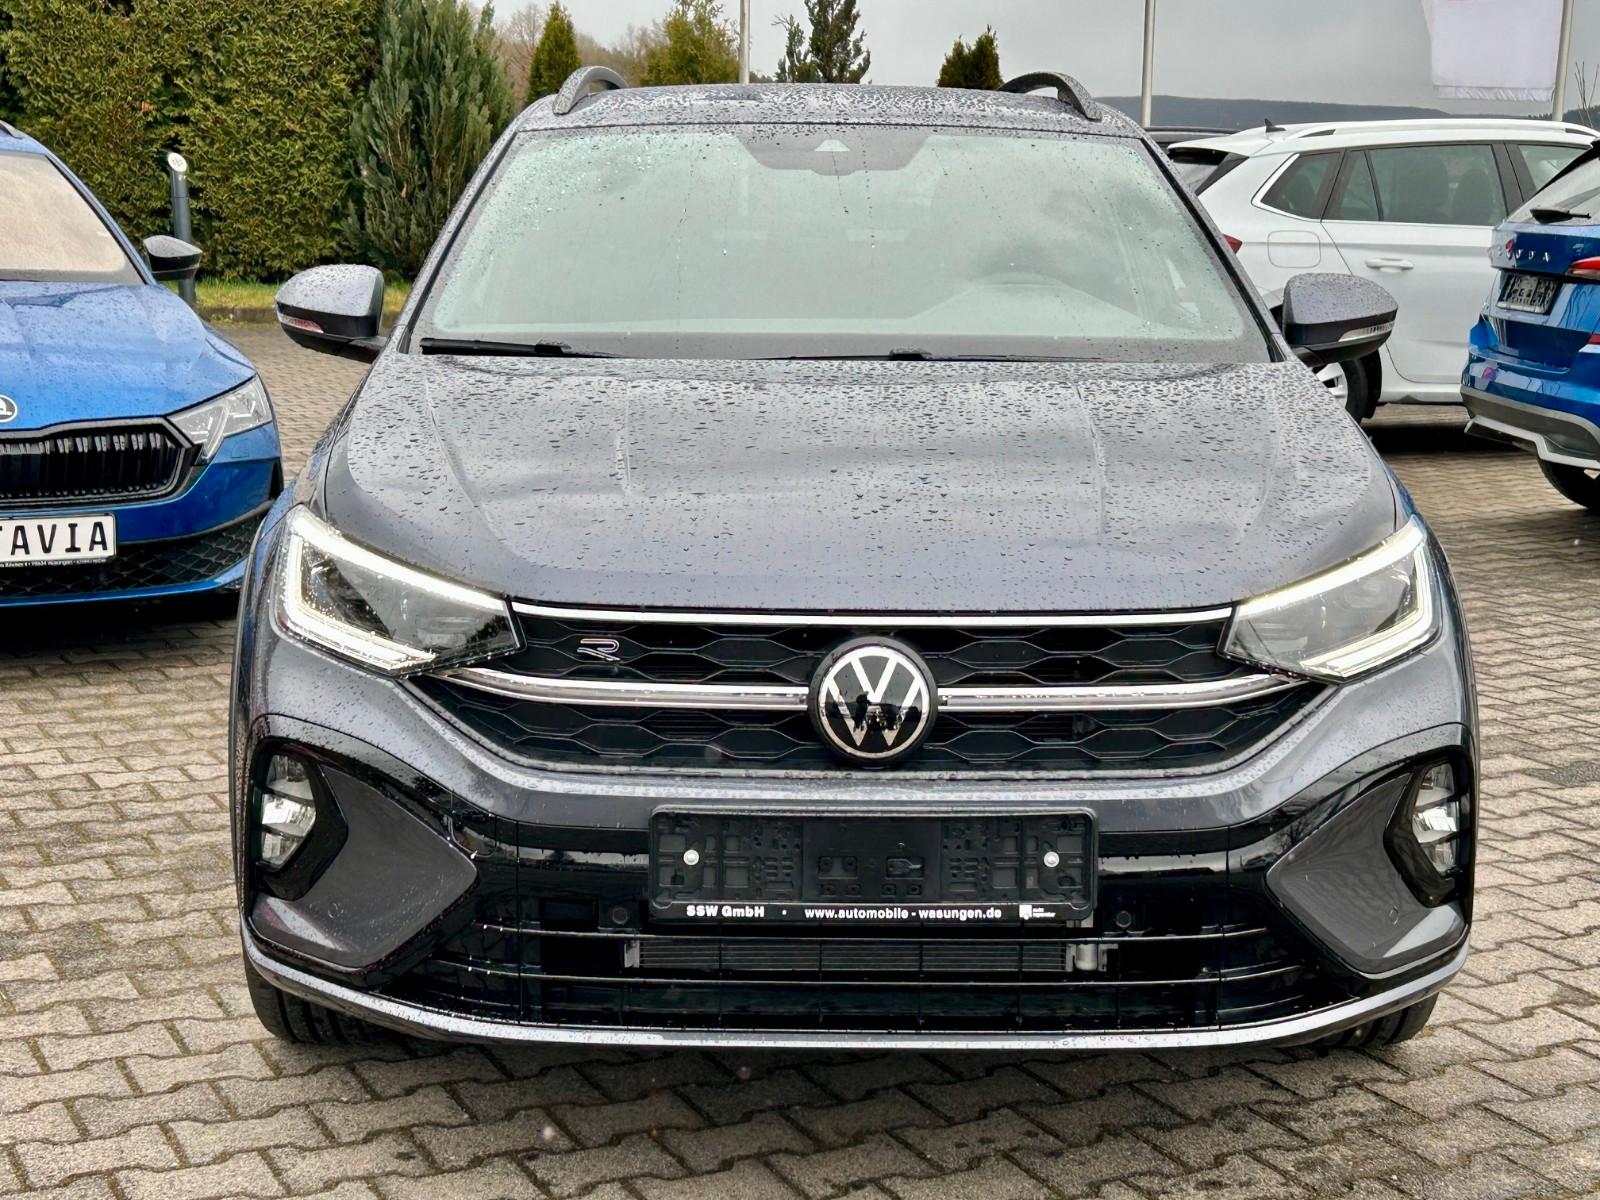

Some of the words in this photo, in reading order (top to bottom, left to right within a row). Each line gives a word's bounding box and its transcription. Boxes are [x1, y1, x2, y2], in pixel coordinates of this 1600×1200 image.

[0, 522, 108, 556] AVIA
[686, 904, 718, 917] SSW
[721, 905, 765, 918] GmbH
